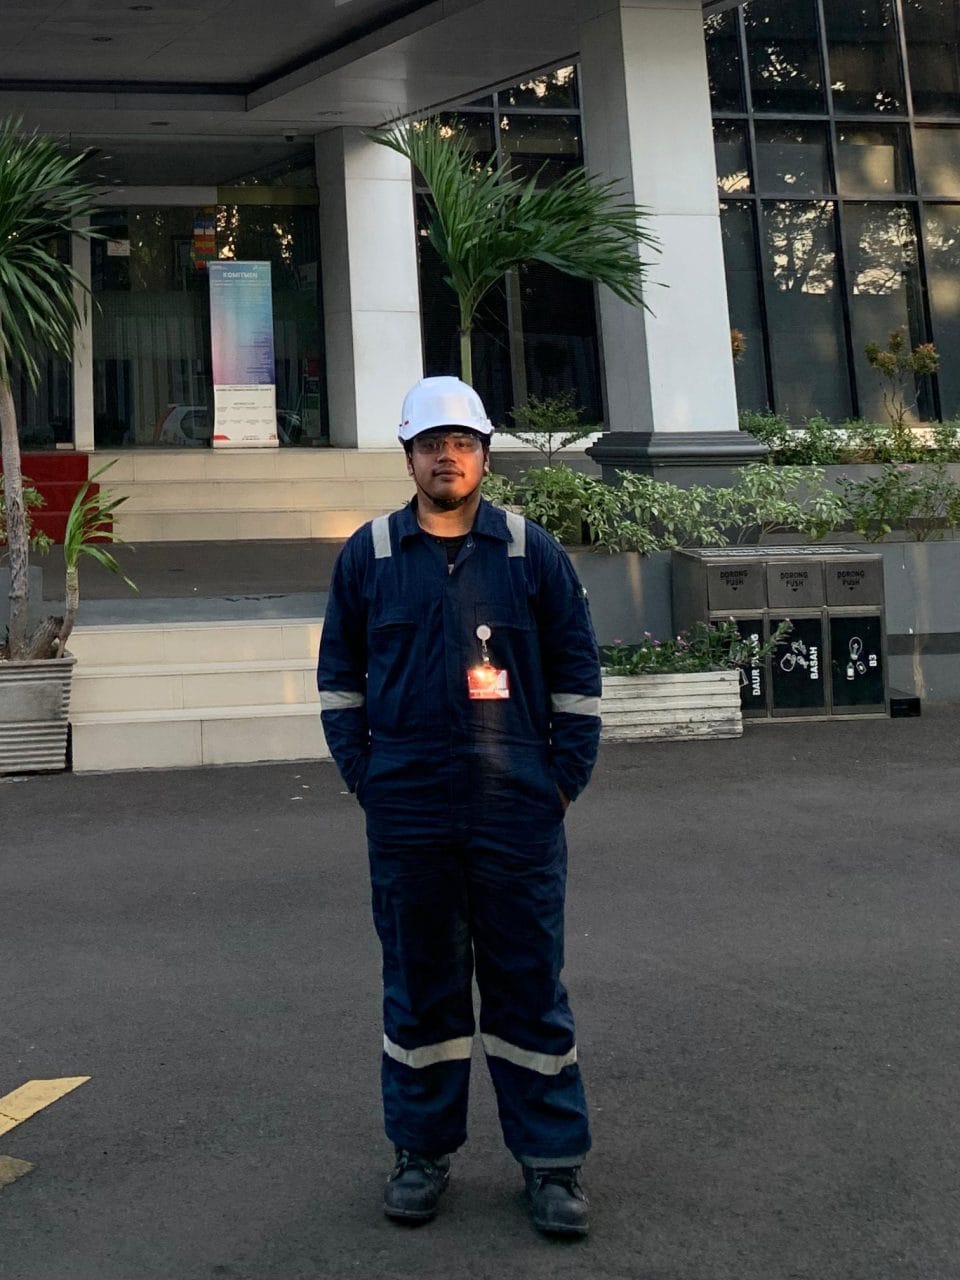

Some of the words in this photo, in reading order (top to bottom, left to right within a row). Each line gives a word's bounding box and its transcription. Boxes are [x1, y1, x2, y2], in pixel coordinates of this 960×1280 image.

[720, 570, 748, 579] DORONG
[780, 571, 808, 580] DORONG
[837, 570, 865, 578] DORONG
[786, 579, 804, 588] PUSH
[842, 578, 860, 586] PUSH
[809, 646, 819, 679] BASAH
[869, 654, 878, 667] B3
[751, 669, 761, 696] DAUR
